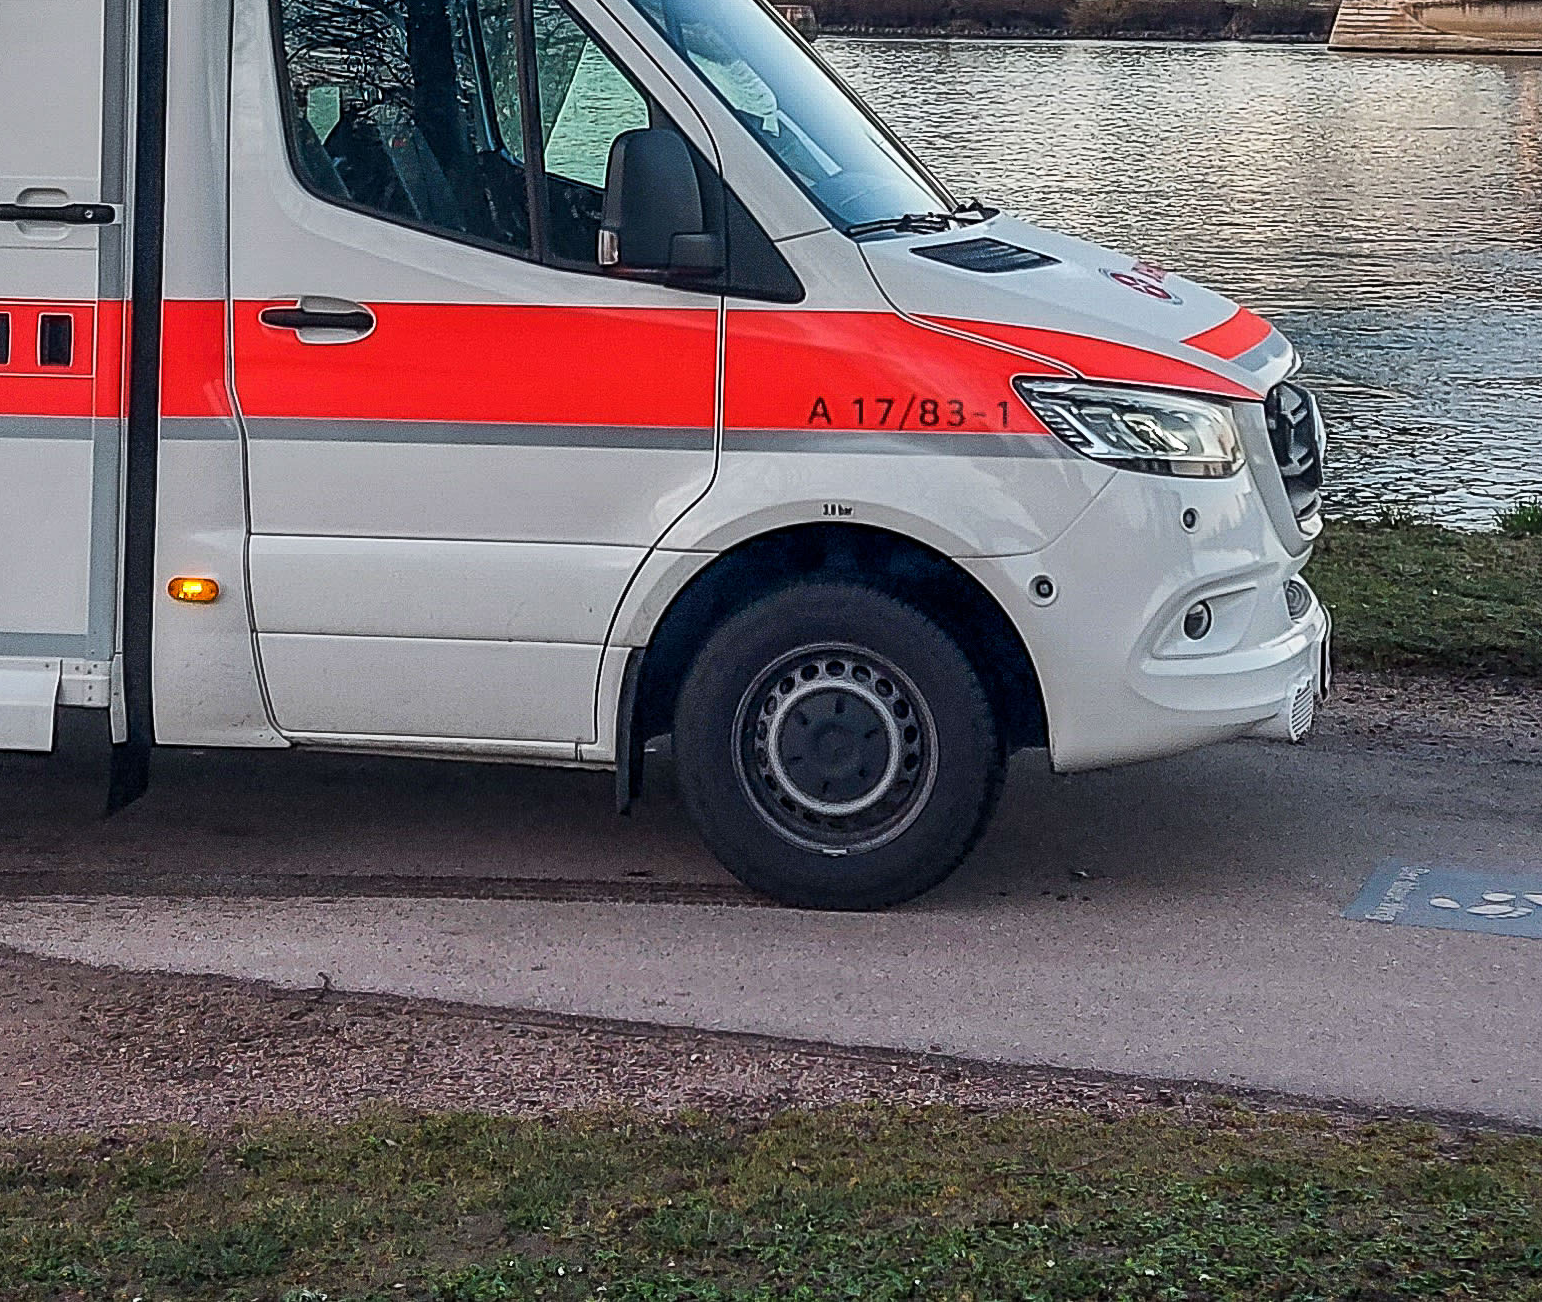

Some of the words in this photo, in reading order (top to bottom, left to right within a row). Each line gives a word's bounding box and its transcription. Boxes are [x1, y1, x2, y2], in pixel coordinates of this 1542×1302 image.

[809, 396, 832, 425] A
[852, 394, 1009, 431] 17/83-1
[838, 503, 853, 516] bar
